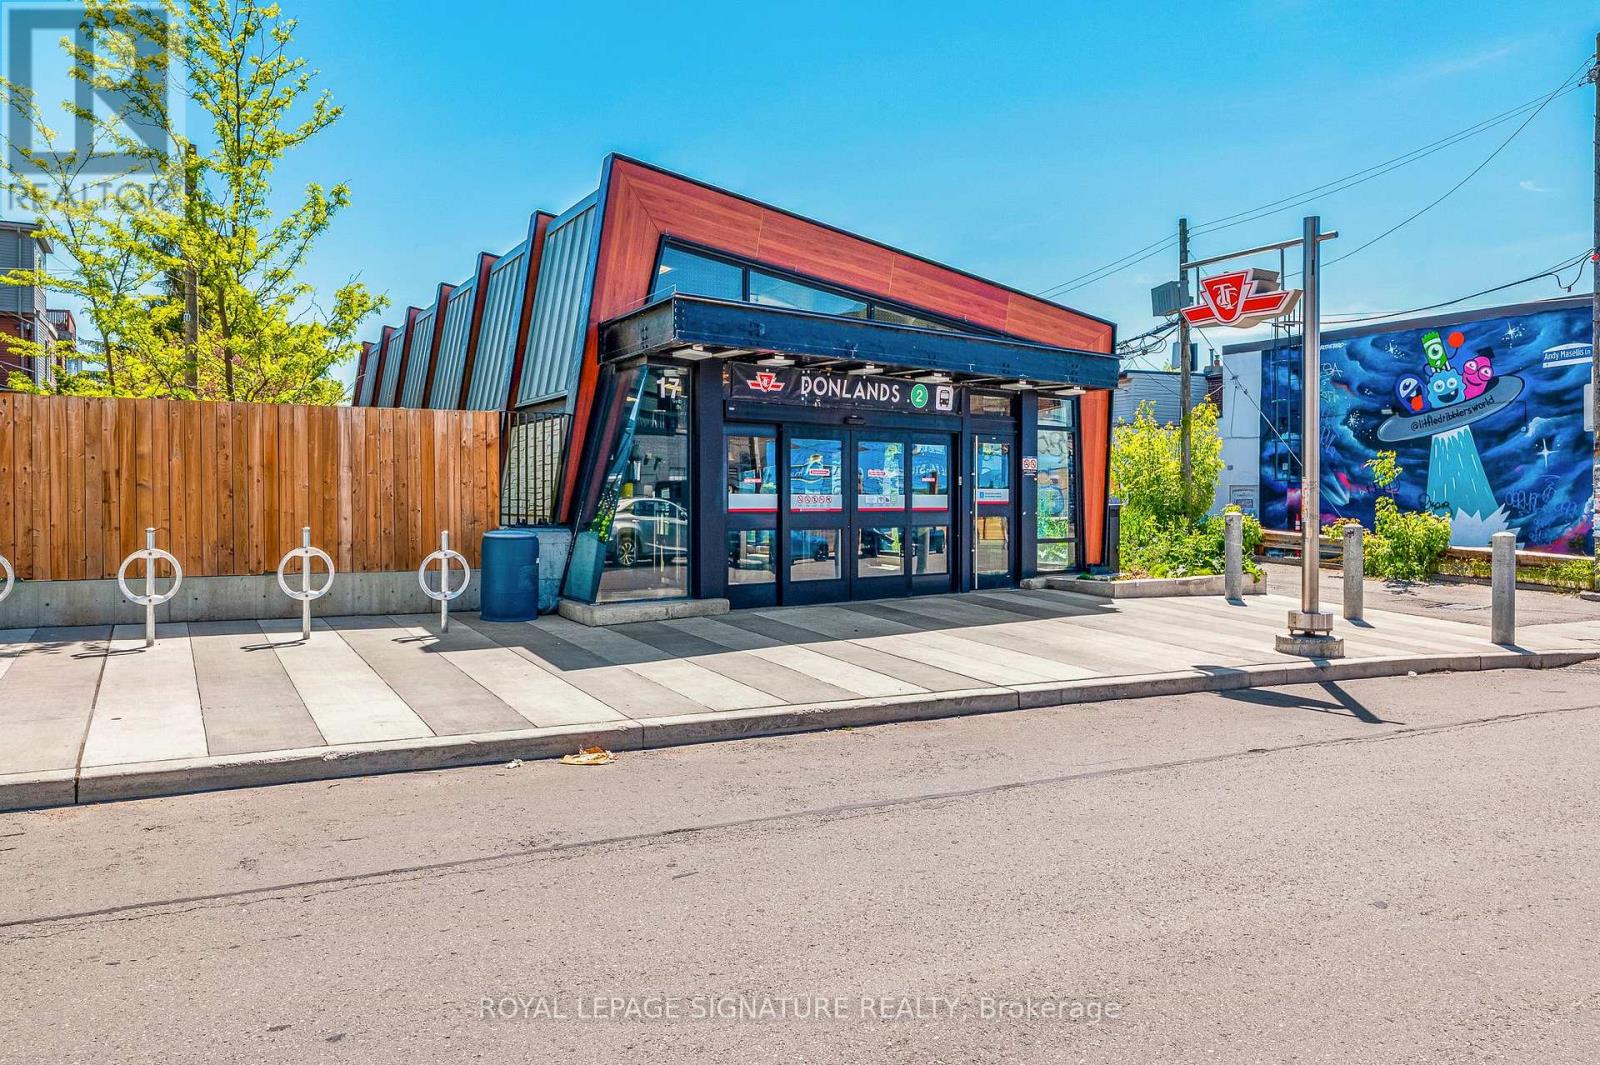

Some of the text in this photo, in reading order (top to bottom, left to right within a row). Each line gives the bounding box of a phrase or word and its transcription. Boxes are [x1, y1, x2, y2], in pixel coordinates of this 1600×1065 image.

[1544, 351, 1560, 361] Andy
[1560, 349, 1585, 358] Masellis
[656, 376, 680, 399] 17
[800, 375, 901, 403] DONLANDS
